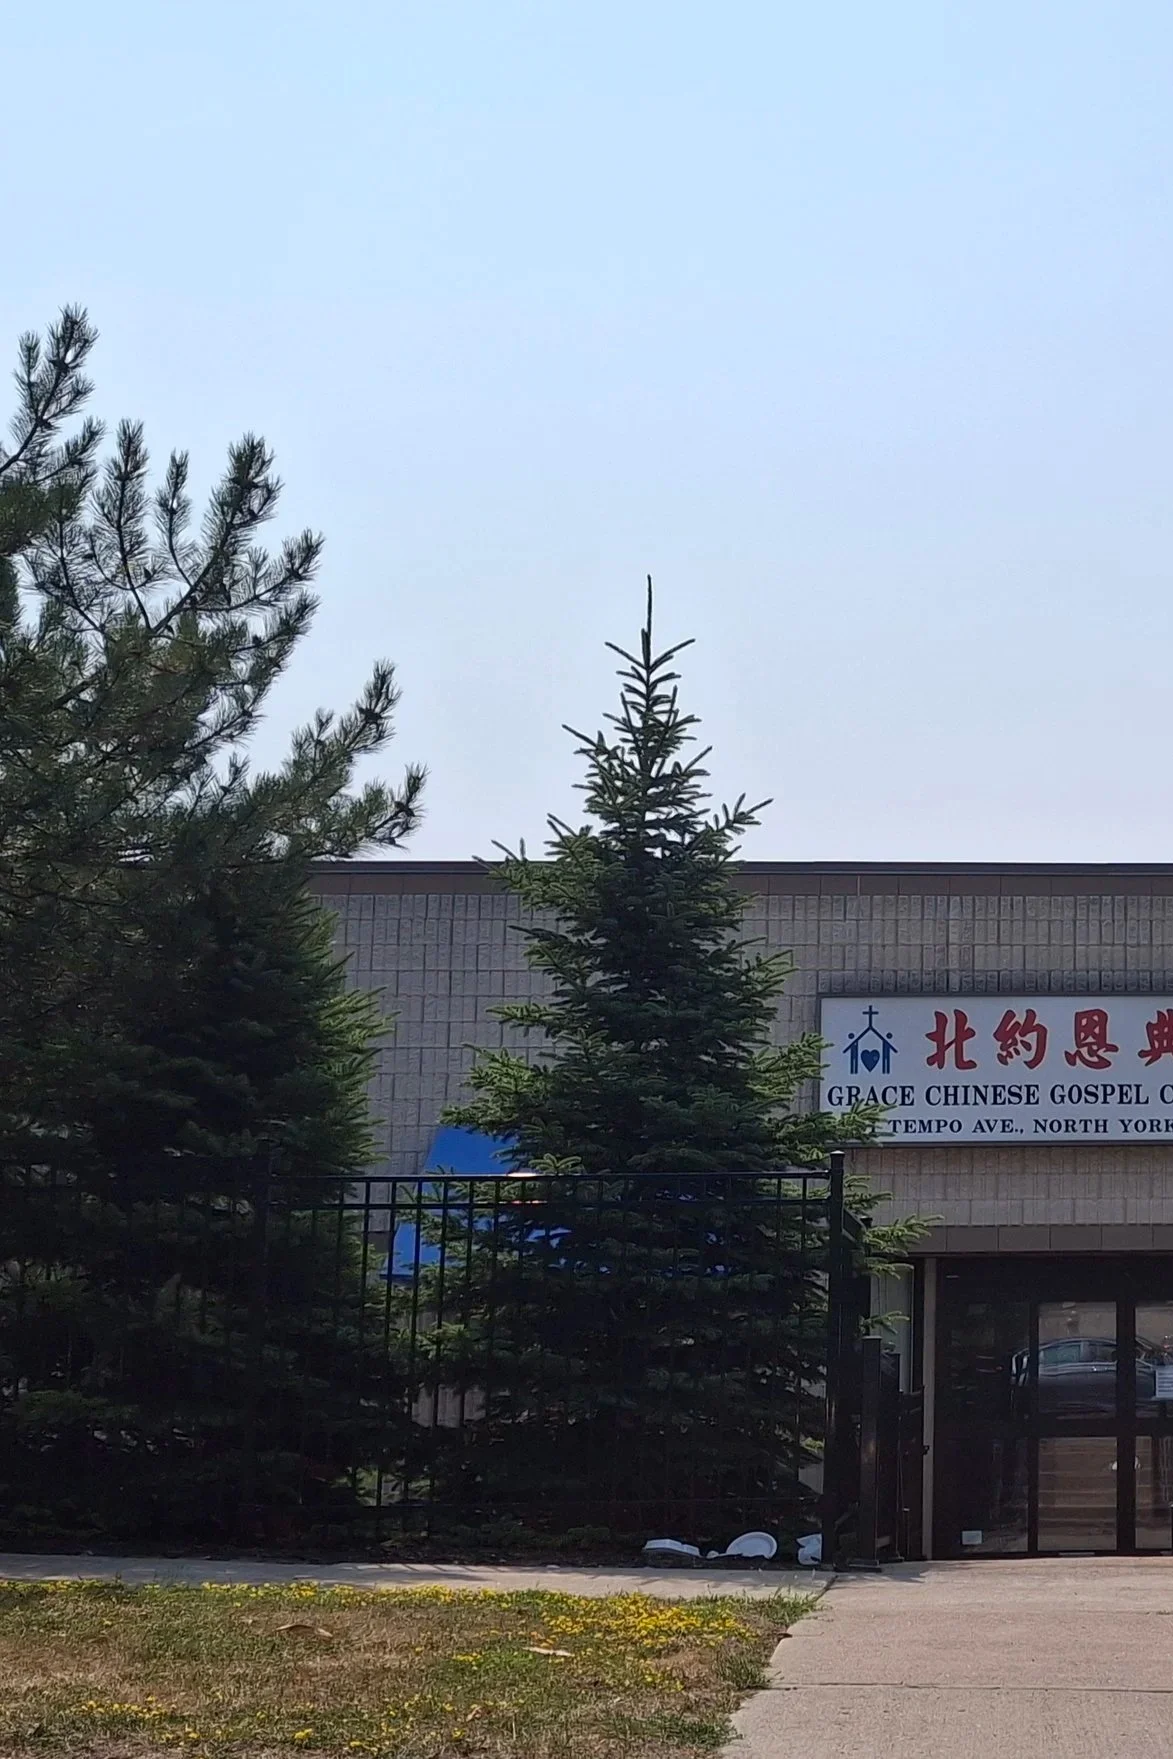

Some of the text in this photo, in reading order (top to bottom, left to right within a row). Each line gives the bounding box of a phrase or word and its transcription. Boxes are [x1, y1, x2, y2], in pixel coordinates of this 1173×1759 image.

[827, 1085, 915, 1106] GRACE
[925, 1084, 1040, 1106] CHINESE
[1049, 1083, 1150, 1105] GOSPEL
[888, 1119, 963, 1134] TEMPO
[1033, 1118, 1109, 1134] NORTH
